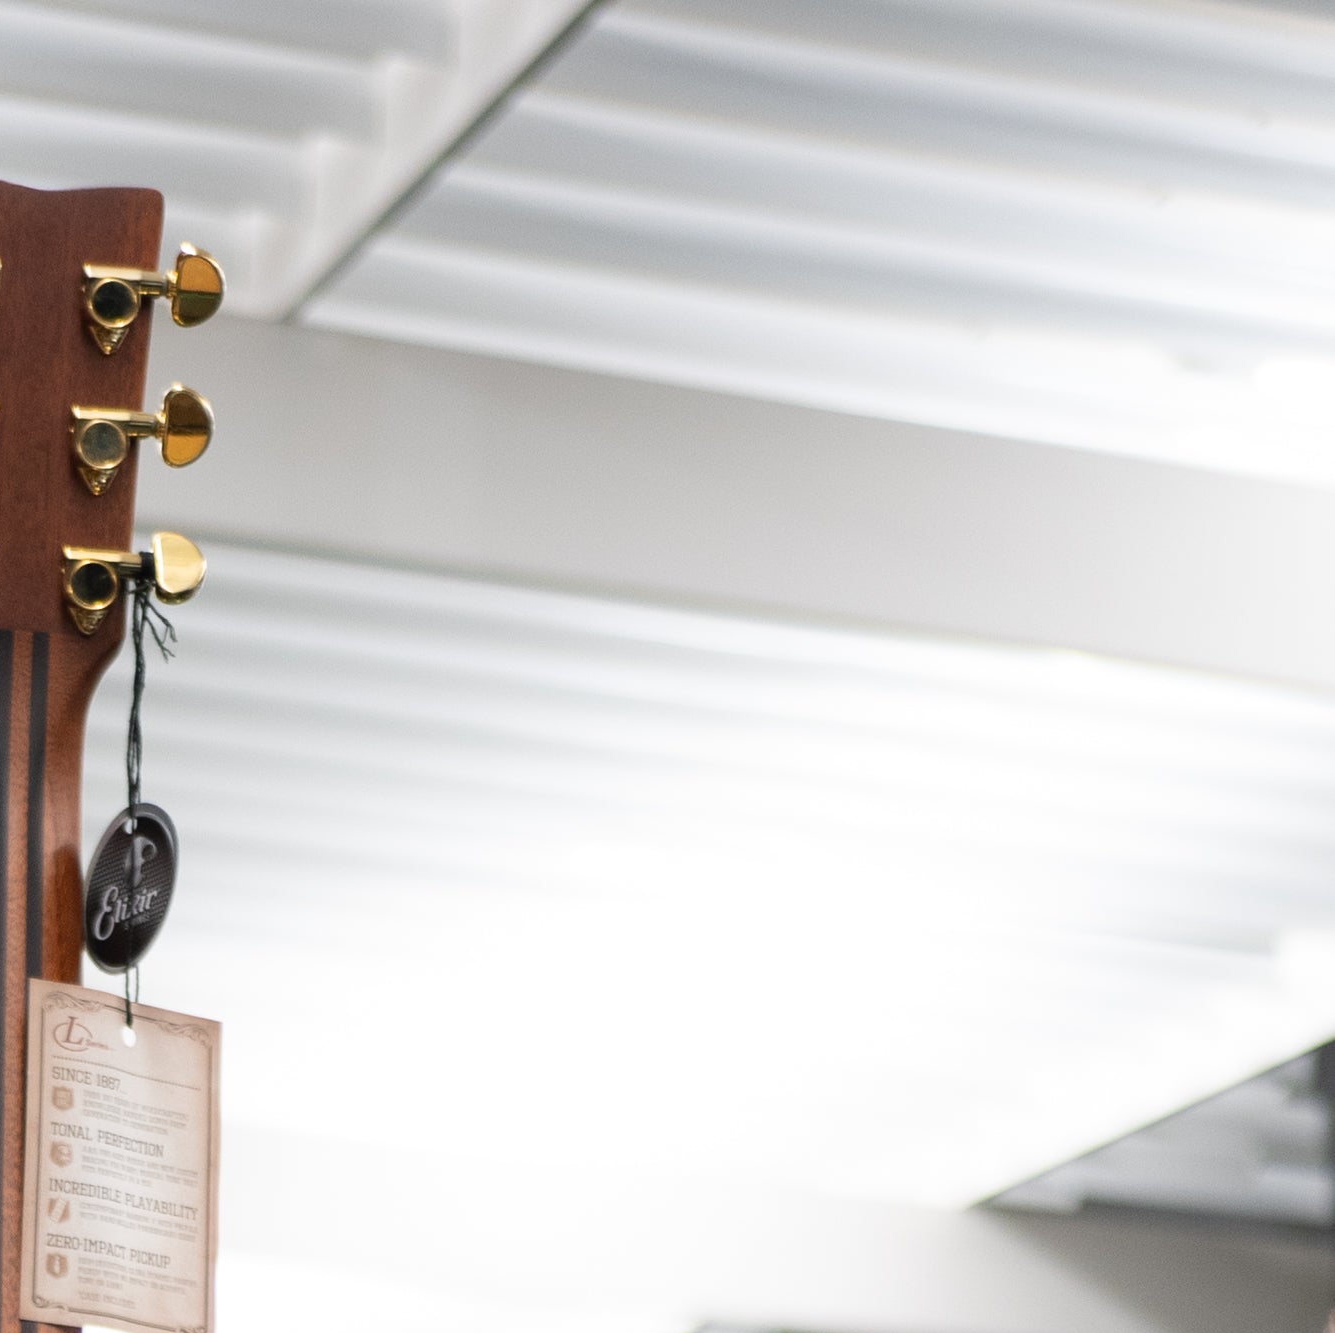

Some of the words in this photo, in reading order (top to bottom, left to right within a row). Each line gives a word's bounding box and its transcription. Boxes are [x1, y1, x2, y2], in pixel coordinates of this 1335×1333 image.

[61, 1015, 84, 1045] L
[52, 1066, 93, 1085] SINCE
[50, 1121, 92, 1141] TONAL
[97, 1130, 165, 1157] PERFECTION
[48, 1178, 122, 1204] INCREDIBLE
[125, 1193, 199, 1221] PLAYABILITY
[46, 1232, 126, 1260] ZERO-IMPACT
[129, 1248, 171, 1269] PICKUP
